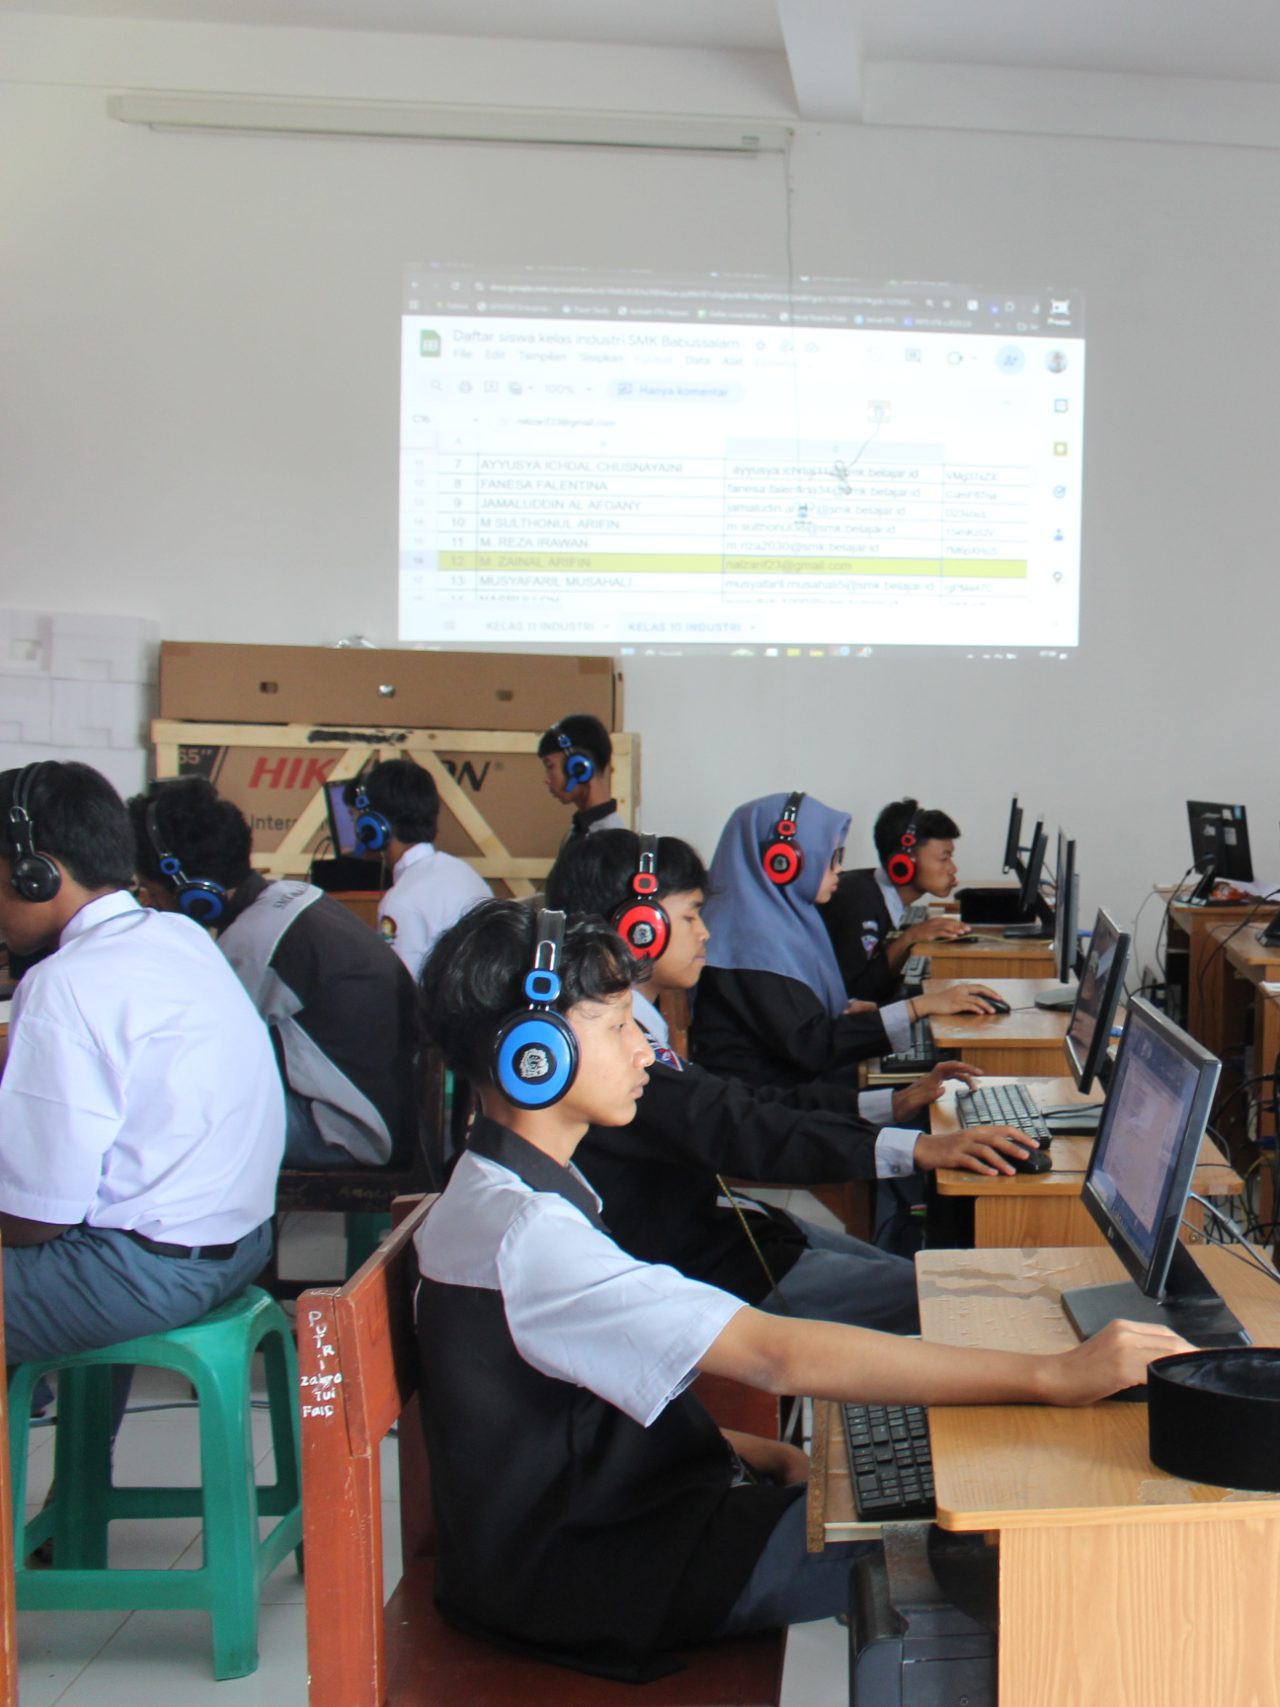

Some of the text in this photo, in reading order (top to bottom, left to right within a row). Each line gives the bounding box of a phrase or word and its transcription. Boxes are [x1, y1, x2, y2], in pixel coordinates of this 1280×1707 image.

[453, 329, 494, 342] Daftar
[500, 331, 535, 342] siswa
[539, 331, 572, 344] kelas
[576, 334, 624, 345] industri
[628, 334, 657, 346] SMK
[453, 349, 472, 359] File
[485, 350, 505, 360] Edit
[677, 386, 728, 397] komentar
[481, 459, 541, 471] AYYUSYA
[480, 479, 608, 491] FANESA FALENTINA
[480, 498, 641, 512] JAMALUDDIN AL AFGANY
[452, 517, 465, 528] 10
[577, 519, 620, 529] ARIFIN
[498, 536, 534, 547] REZA
[537, 537, 588, 548] IRAWAN
[451, 556, 465, 567] 12
[499, 556, 544, 567] ZAINAL
[548, 557, 592, 568] ARIFIN
[485, 621, 524, 632] KELAS
[540, 622, 594, 633] INDUSTRI
[628, 622, 742, 634] KELAS 10 INDUSTRI
